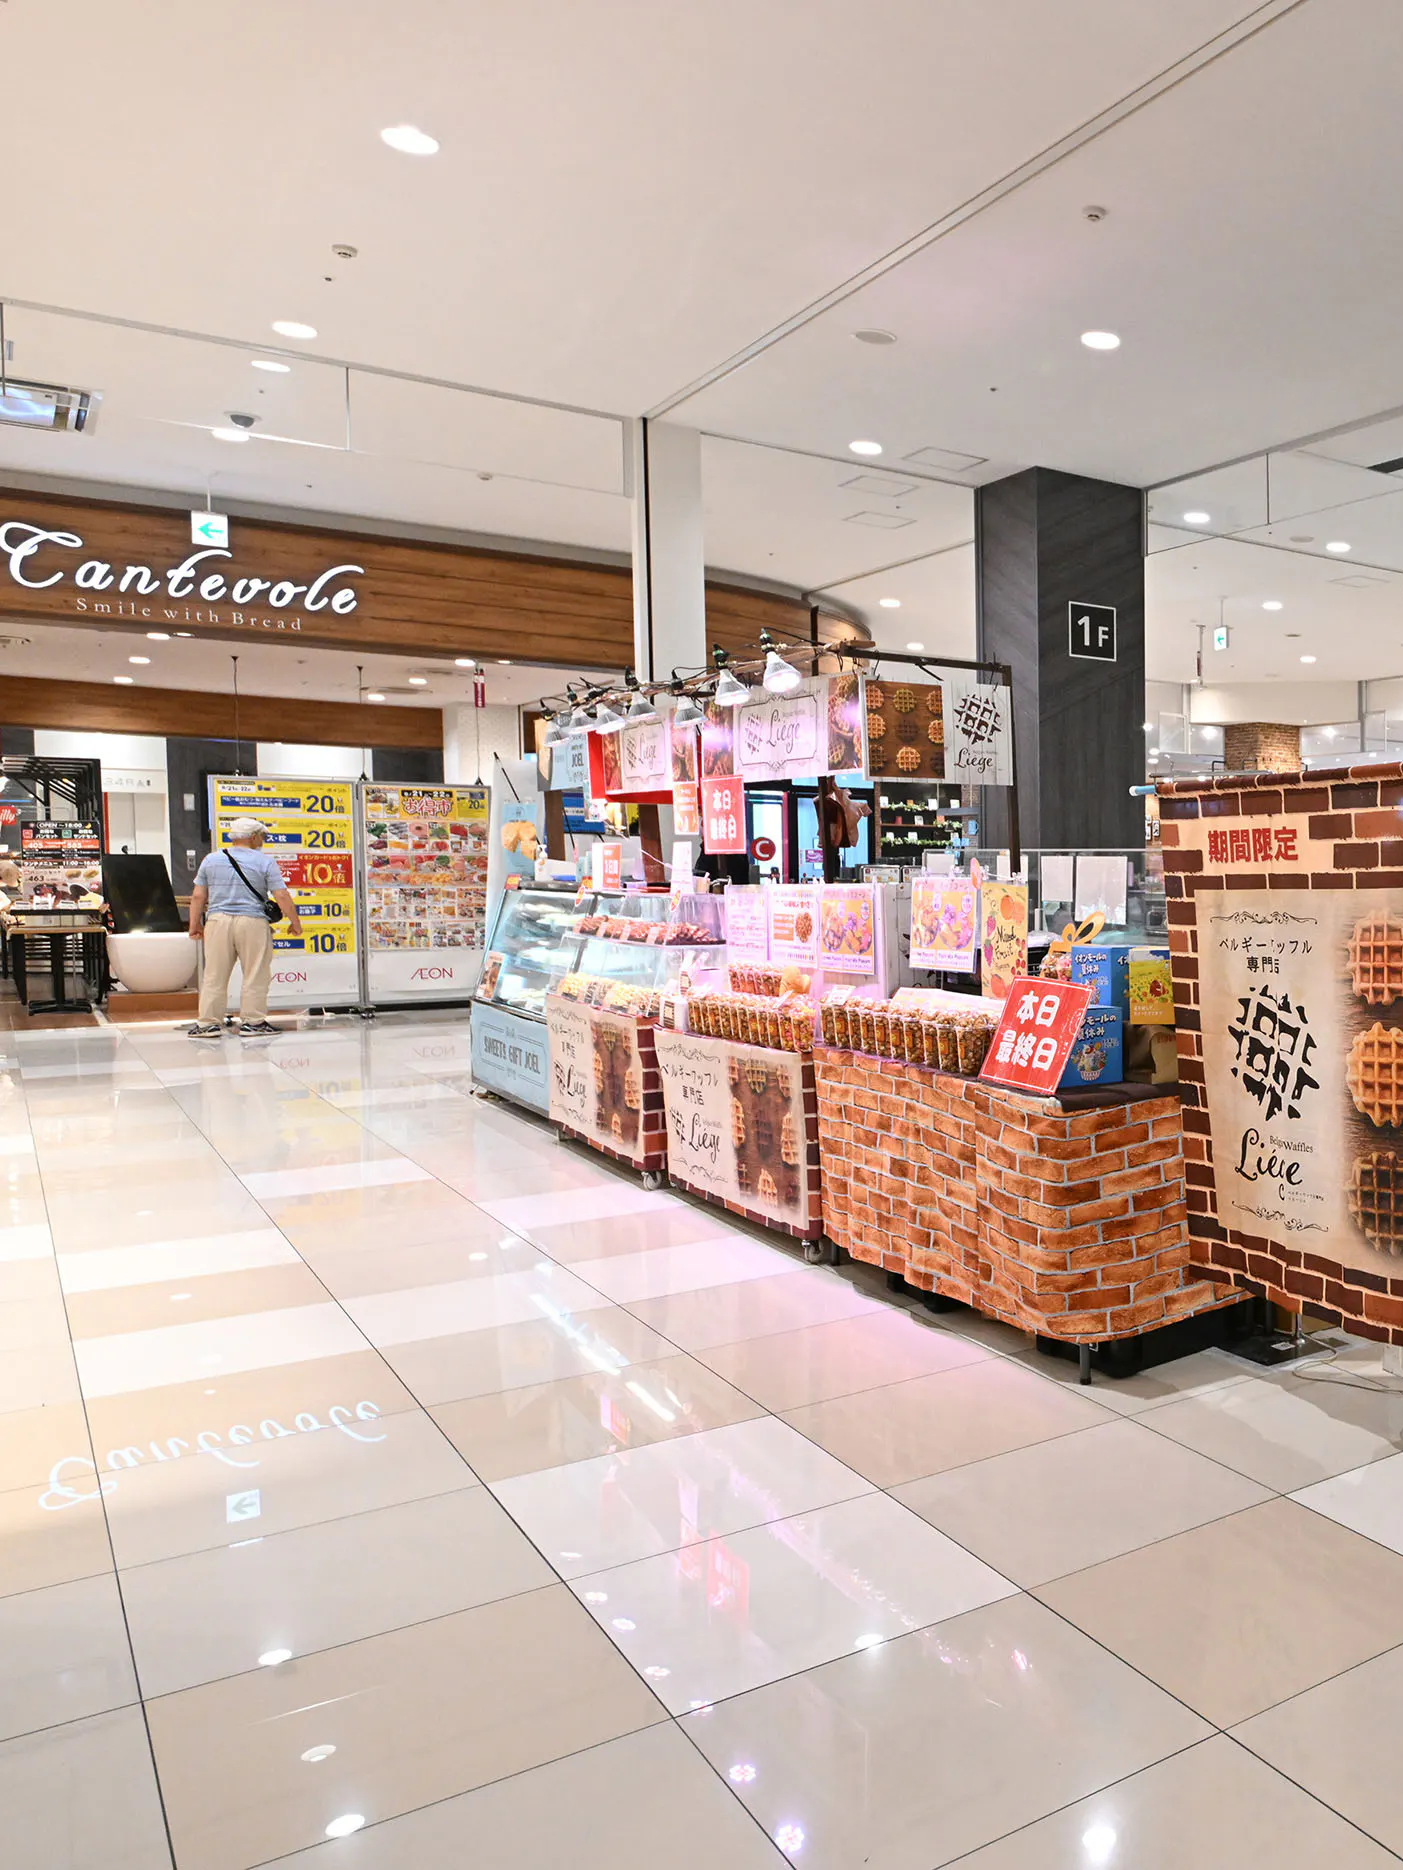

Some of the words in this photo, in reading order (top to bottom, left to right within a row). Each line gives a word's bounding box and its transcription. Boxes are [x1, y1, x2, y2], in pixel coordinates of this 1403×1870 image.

[0, 521, 365, 614] Cantevole
[77, 597, 151, 617] Smile
[164, 608, 220, 623] with
[233, 612, 302, 631] Bread
[1078, 616, 1109, 647] 1F
[1208, 826, 1299, 863] 期間限定
[1016, 990, 1061, 1028] 本日
[483, 1035, 507, 1060] SWEETS
[508, 1046, 523, 1067] GIFT
[524, 1053, 540, 1075] JOEL
[995, 1029, 1059, 1072] 最終日
